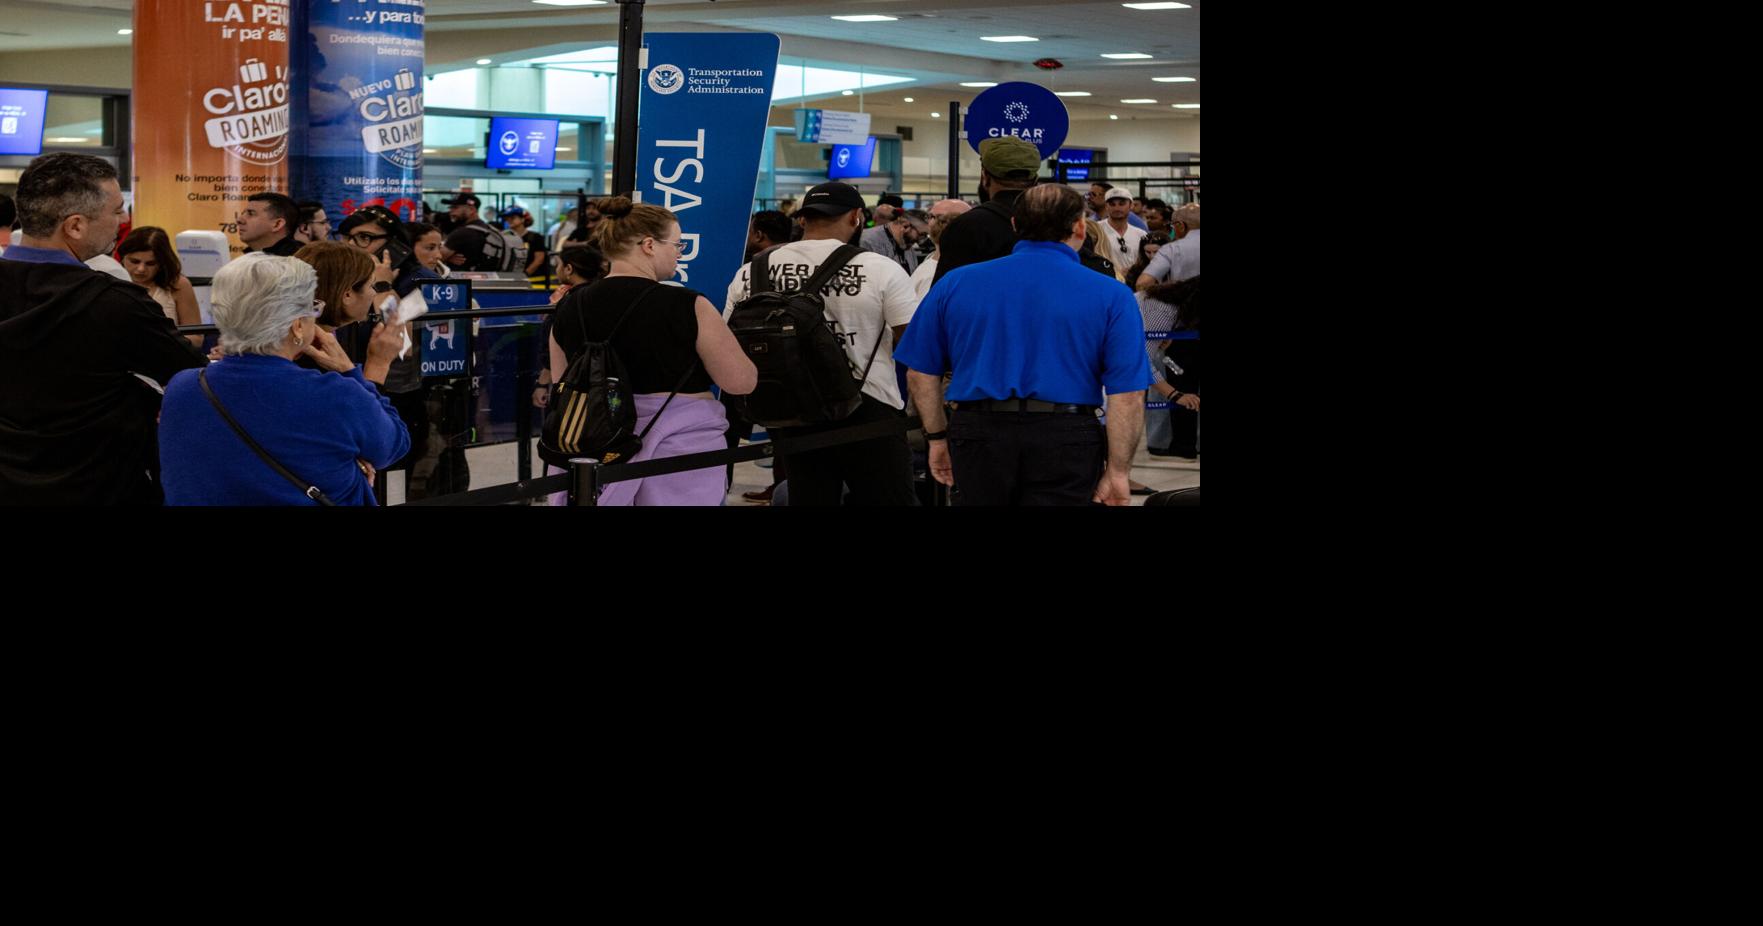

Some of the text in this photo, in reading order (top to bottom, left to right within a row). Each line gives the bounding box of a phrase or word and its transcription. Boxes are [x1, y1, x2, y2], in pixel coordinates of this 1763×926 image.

[205, 2, 244, 22] LA
[379, 11, 411, 25] para
[222, 25, 236, 39] ir
[688, 67, 763, 77] Transportation
[688, 77, 731, 87] Security
[348, 79, 392, 100] NUEVO
[687, 85, 765, 94] Administration
[203, 82, 286, 115] Claro
[988, 127, 1043, 138] CLEAR
[654, 128, 705, 213] TSA
[175, 174, 191, 183] No
[193, 174, 240, 184] importa
[214, 183, 239, 192] bien
[187, 193, 218, 201] Claro
[742, 263, 809, 282] LWER
[432, 286, 453, 300] K-9
[421, 360, 465, 373] ON DUTY
